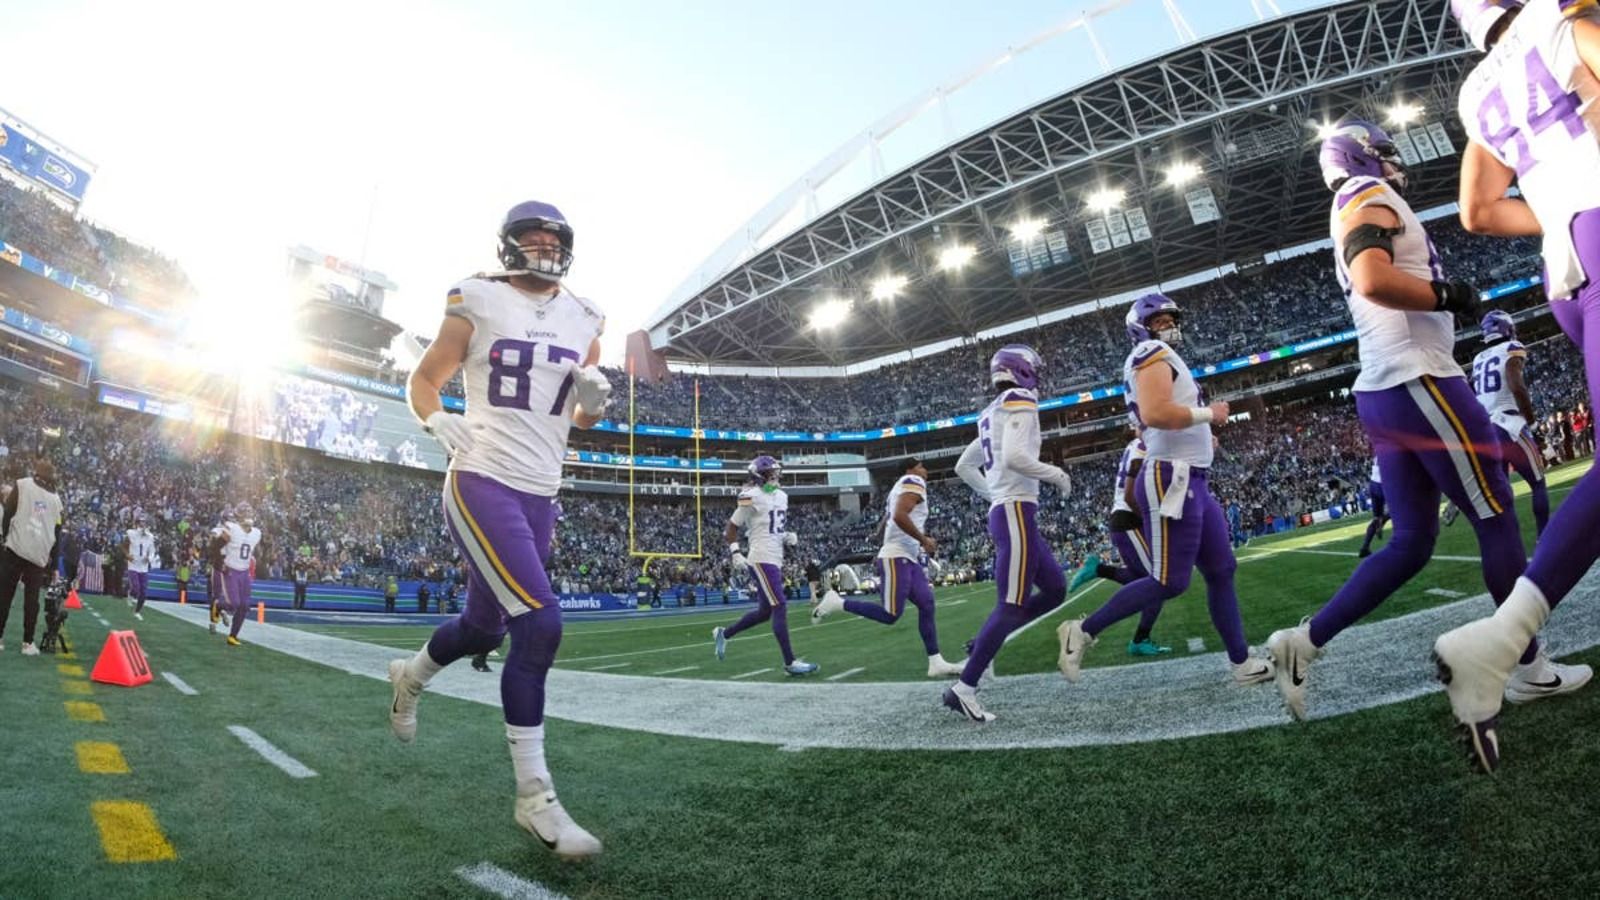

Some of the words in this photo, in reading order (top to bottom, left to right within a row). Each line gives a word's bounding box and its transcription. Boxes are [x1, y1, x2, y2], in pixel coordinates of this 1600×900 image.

[1477, 45, 1587, 178] 84
[488, 338, 580, 416] 87
[640, 486, 681, 496] HOME
[692, 486, 710, 496] OF
[720, 486, 740, 496] TH
[768, 510, 786, 534] 13
[240, 543, 250, 560] 0
[559, 596, 601, 609] eahawks
[119, 635, 149, 678] 10
